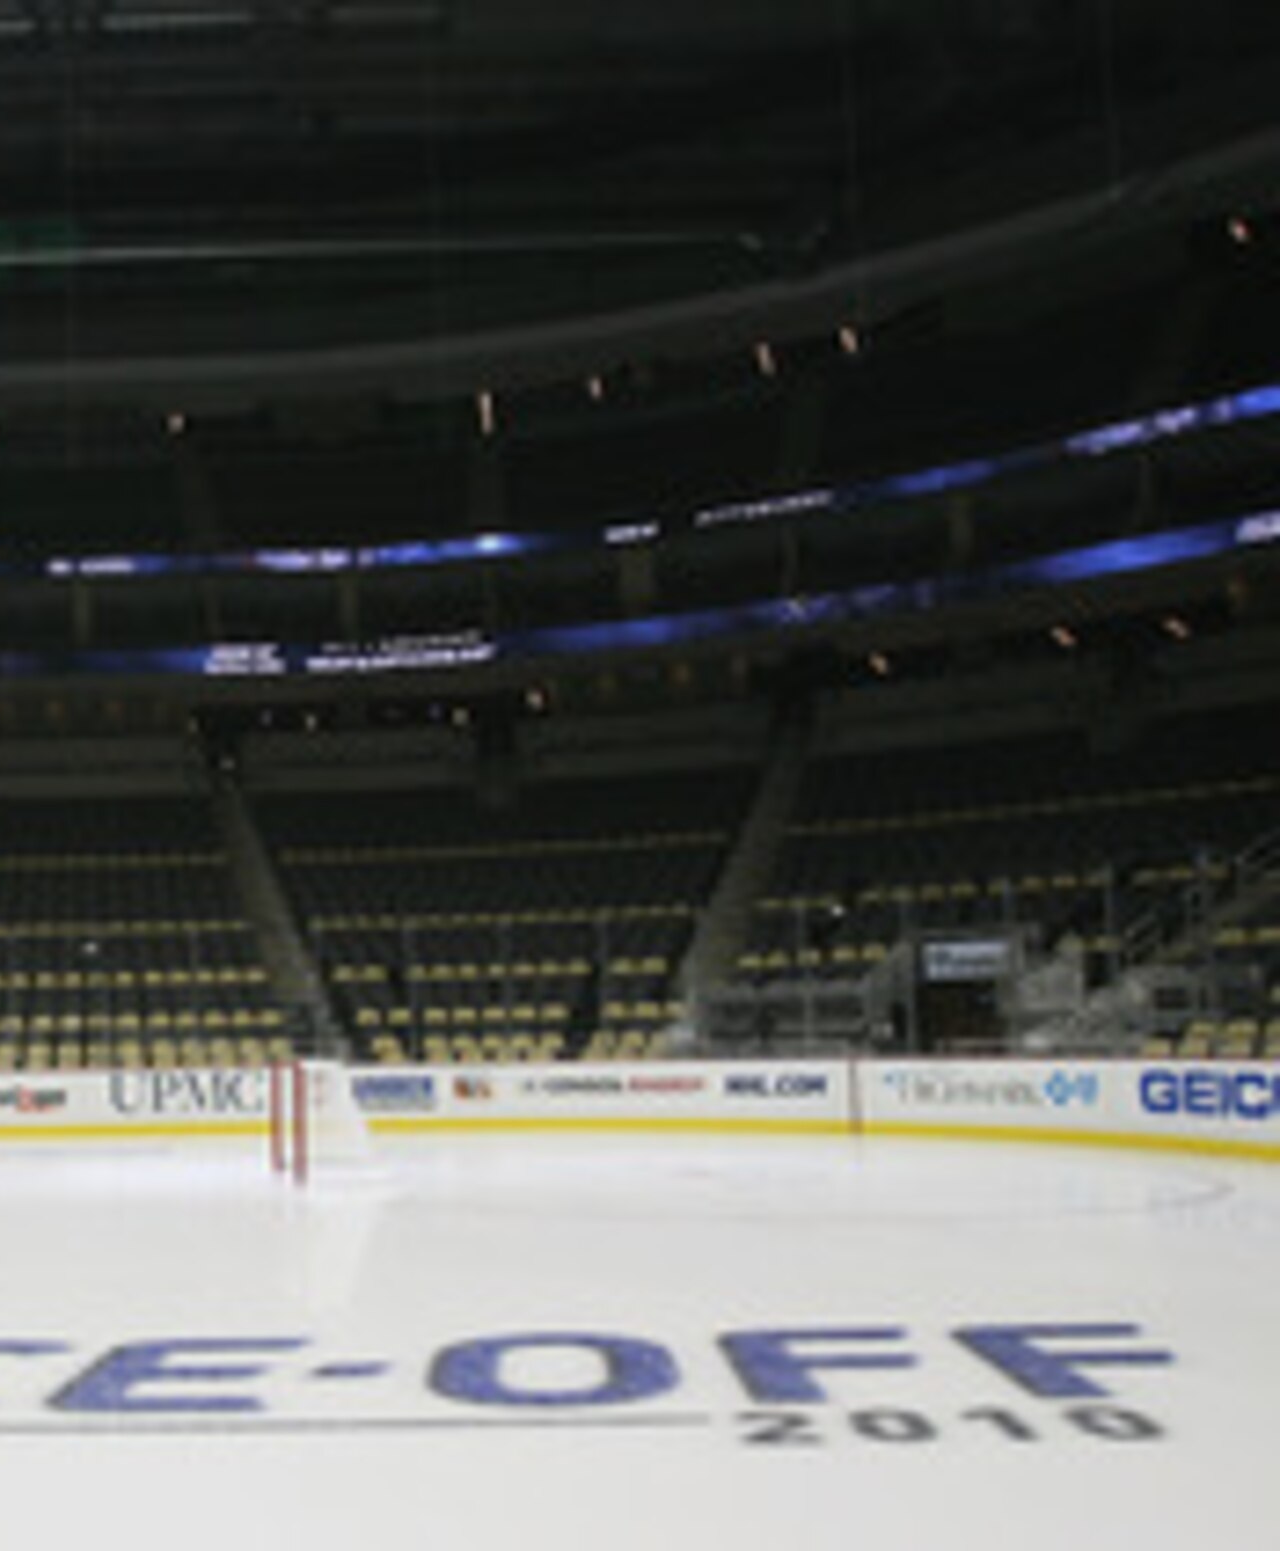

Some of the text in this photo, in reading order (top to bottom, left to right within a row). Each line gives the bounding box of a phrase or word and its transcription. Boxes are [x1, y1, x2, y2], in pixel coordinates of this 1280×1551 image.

[107, 1072, 264, 1113] UPMC
[724, 1073, 828, 1098] NHL.COM
[734, 1406, 1168, 1446] 2010
